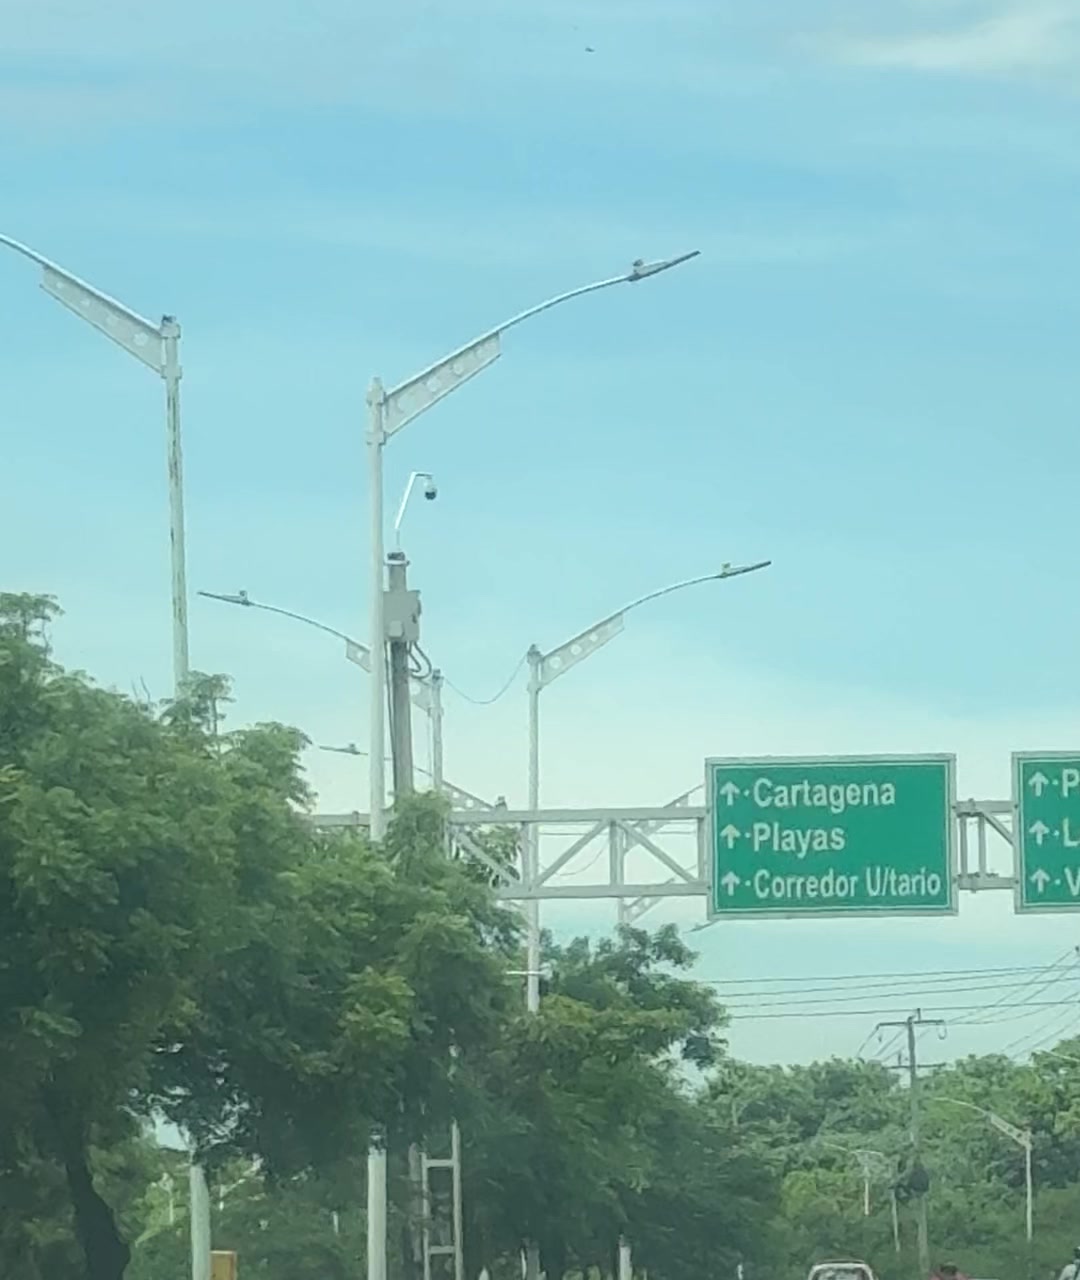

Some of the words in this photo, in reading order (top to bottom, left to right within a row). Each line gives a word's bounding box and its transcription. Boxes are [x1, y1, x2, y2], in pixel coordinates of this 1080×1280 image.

[753, 778, 896, 814] Cartagena
[753, 822, 846, 859] Playas
[754, 868, 859, 900] Corredor
